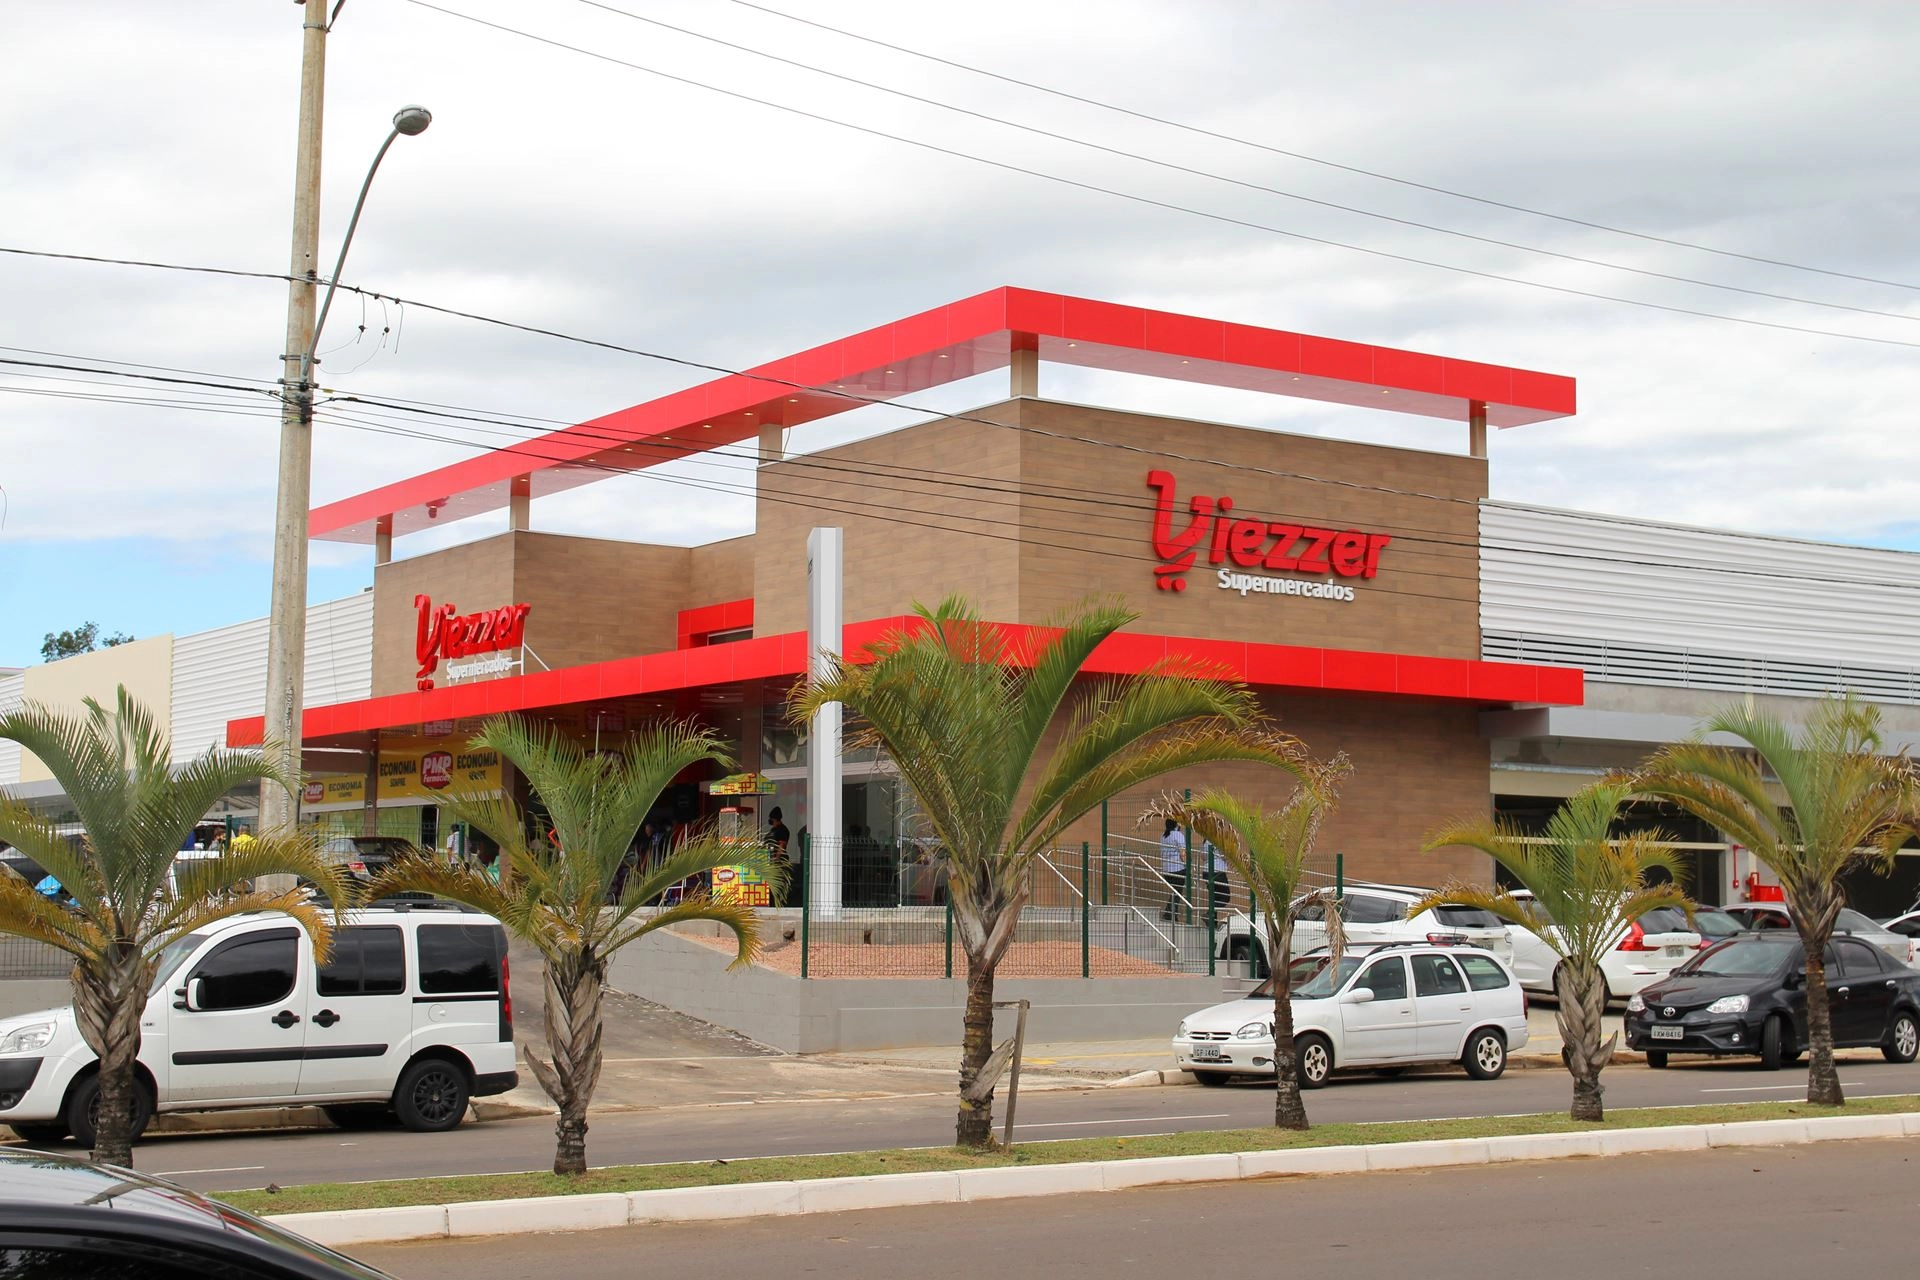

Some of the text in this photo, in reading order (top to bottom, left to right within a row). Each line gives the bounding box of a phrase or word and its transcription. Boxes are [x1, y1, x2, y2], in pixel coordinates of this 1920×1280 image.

[1147, 470, 1392, 582] Viezzer
[1217, 567, 1355, 602] Supermercados
[414, 594, 532, 666] Viezzer
[380, 760, 416, 776] ECONOMIA
[423, 756, 452, 774] PMP
[457, 752, 498, 769] ECONOMIA
[329, 781, 362, 792] ECONOMIA
